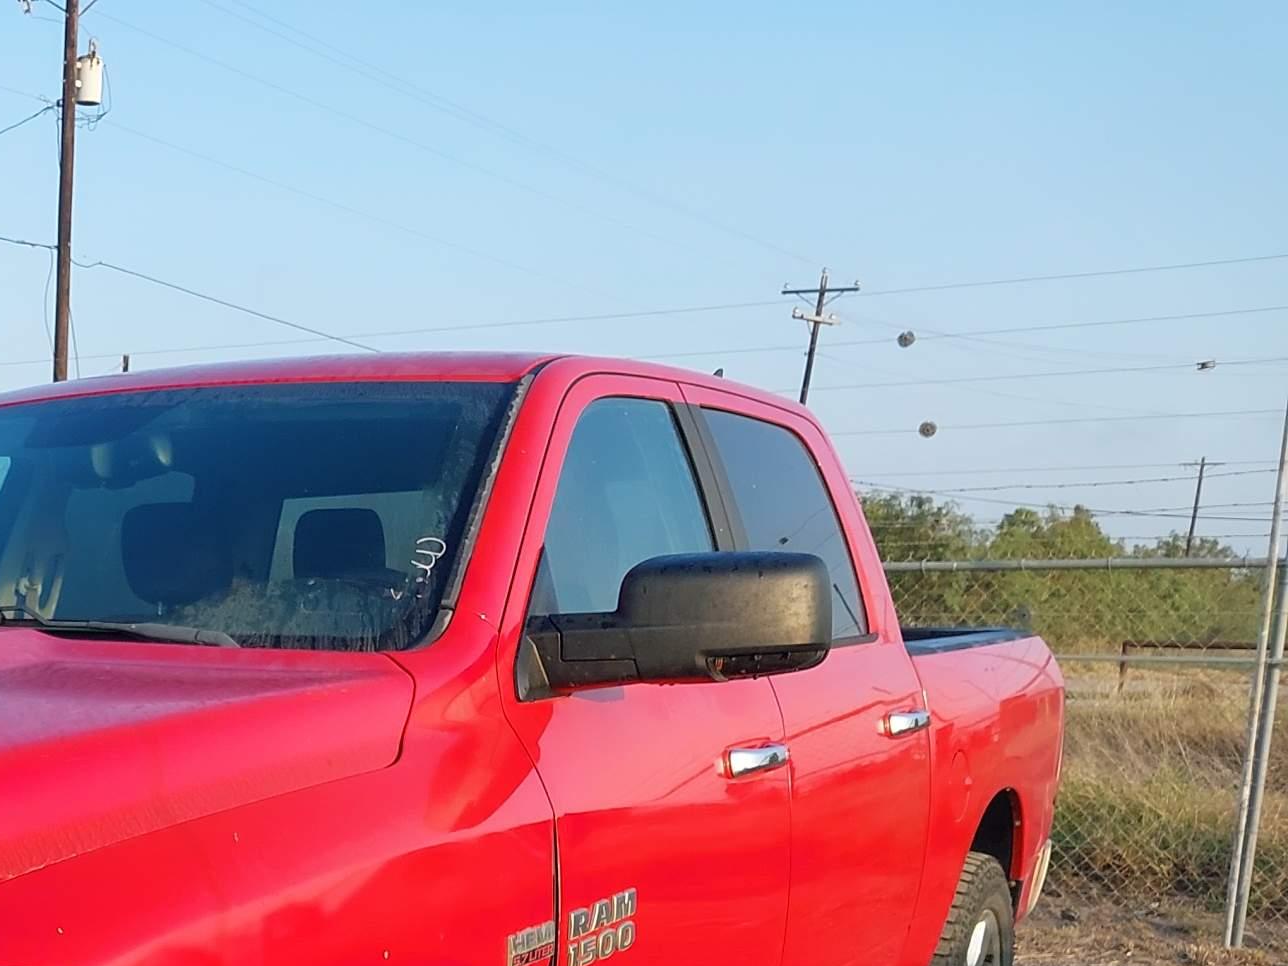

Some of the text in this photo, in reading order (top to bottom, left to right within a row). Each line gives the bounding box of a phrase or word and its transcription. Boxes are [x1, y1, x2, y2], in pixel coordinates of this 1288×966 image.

[569, 887, 637, 940] RAM
[508, 920, 555, 955] HEMI
[529, 943, 553, 962] LITER
